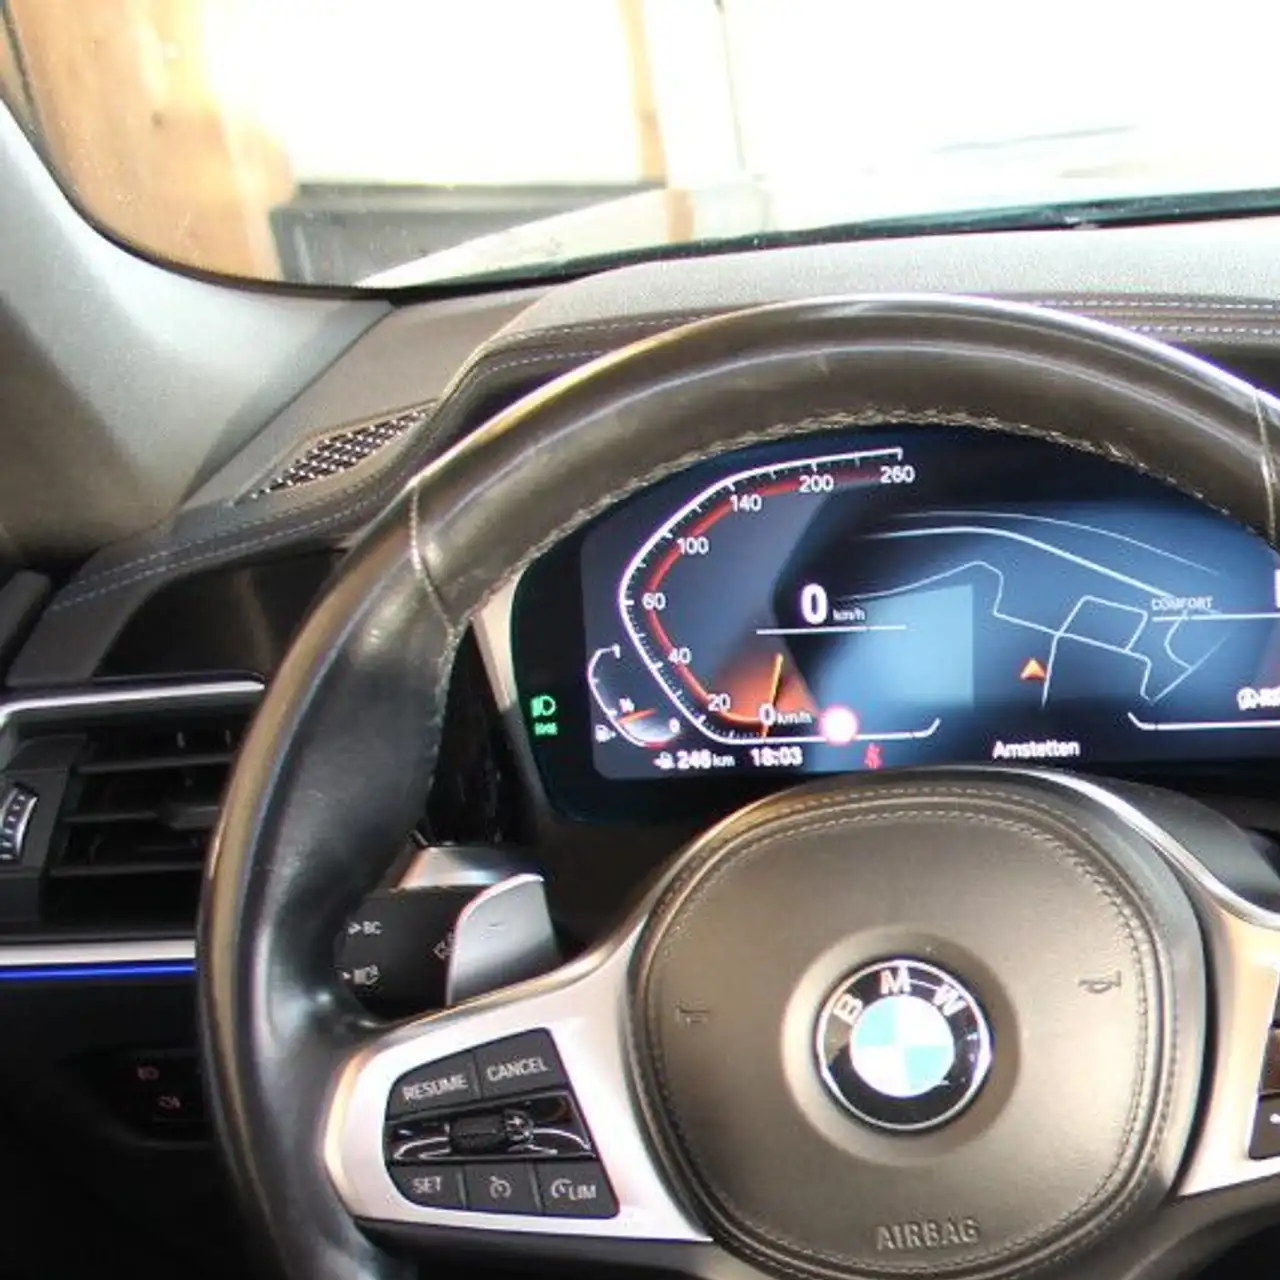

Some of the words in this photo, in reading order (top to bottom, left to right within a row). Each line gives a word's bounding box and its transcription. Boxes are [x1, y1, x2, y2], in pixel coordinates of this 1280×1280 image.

[800, 474, 833, 493] 200
[881, 464, 915, 484] 260
[730, 494, 762, 513] 140
[677, 537, 709, 555] 100
[642, 592, 667, 611] 60
[801, 583, 827, 624] 0
[1152, 596, 1213, 610] COMFORT
[668, 648, 692, 665] 40
[708, 693, 731, 711] 20
[993, 739, 1080, 759] Amstetten
[833, 967, 967, 1026] BMW
[486, 1055, 549, 1082] CANCEL
[402, 1072, 470, 1100] RESUME
[412, 1177, 443, 1194] SET
[875, 1216, 982, 1252] AIRBAG
